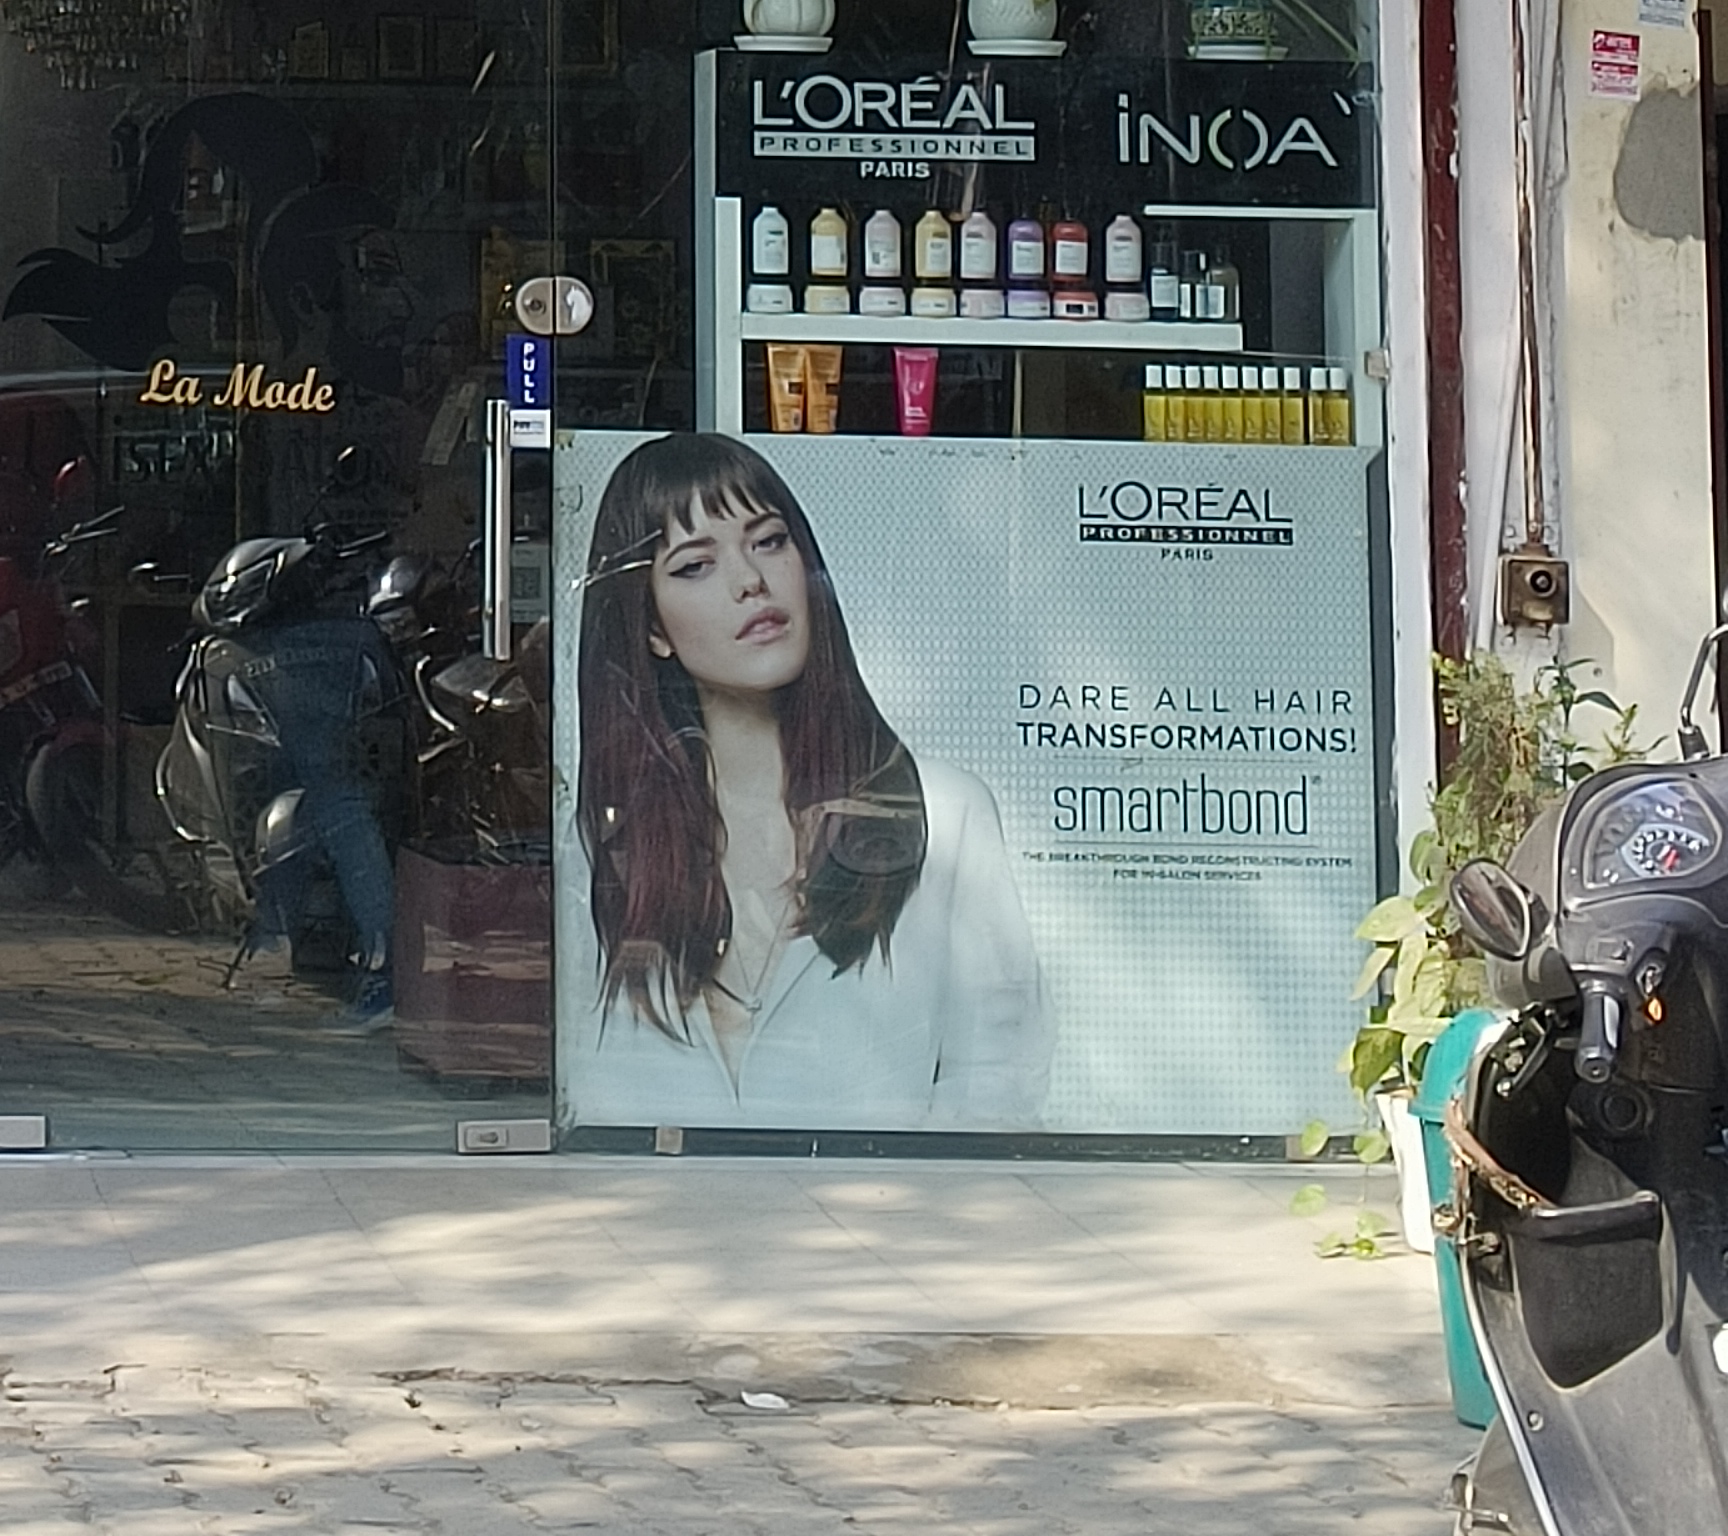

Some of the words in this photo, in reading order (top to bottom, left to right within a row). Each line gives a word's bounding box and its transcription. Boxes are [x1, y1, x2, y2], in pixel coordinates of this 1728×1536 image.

[760, 135, 1030, 158] PROFESSIONNEL
[859, 159, 932, 180] PARIS
[139, 358, 204, 405] La
[213, 362, 337, 412] Mode
[523, 342, 536, 404] PULL
[1082, 525, 1292, 544] PROFESSIONNEL
[1160, 548, 1214, 561] PARIS
[1018, 683, 1131, 711] DARE
[1154, 687, 1232, 714] ALL
[1254, 689, 1353, 716] HAIR
[1016, 721, 1358, 754] TRANSFORMATIONS!
[1053, 772, 1310, 836] smartbond
